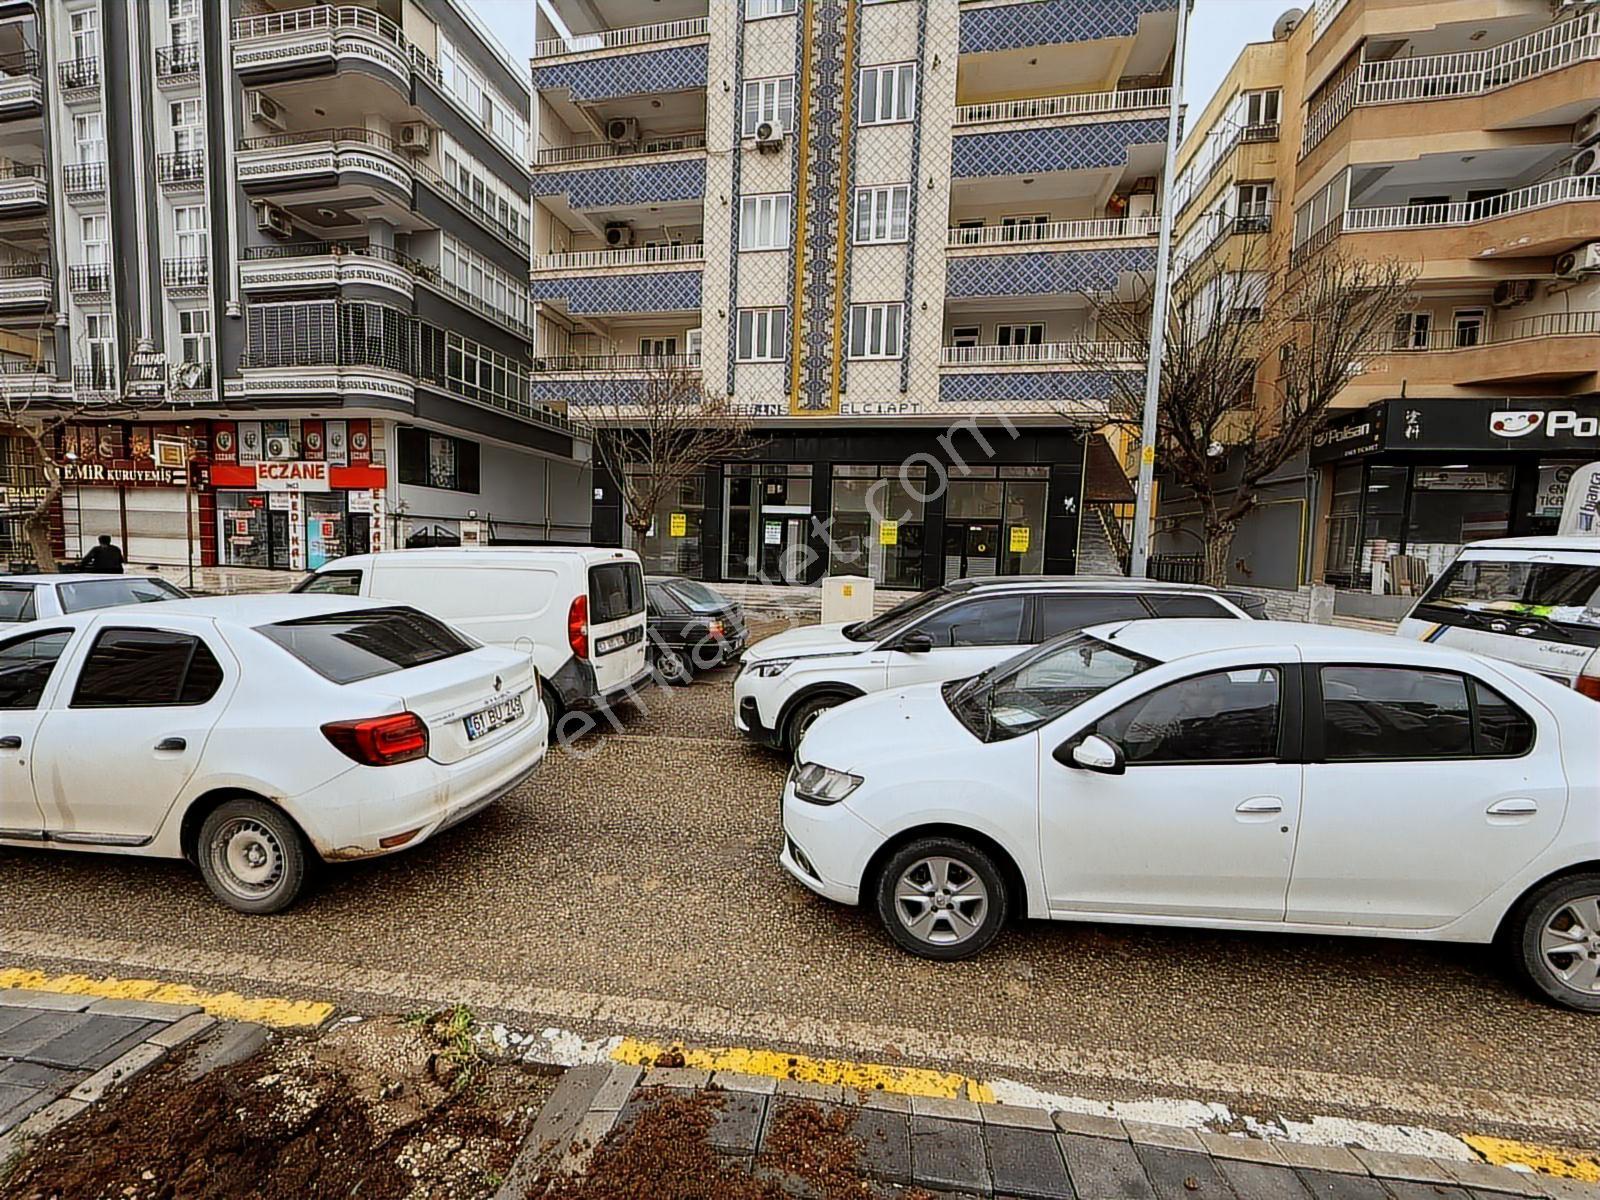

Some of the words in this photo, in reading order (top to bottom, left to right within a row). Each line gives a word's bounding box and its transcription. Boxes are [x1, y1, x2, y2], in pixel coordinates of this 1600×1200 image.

[1546, 410, 1600, 437] Po
[258, 463, 325, 479] ECZANE
[1539, 493, 1564, 506] TİCA
